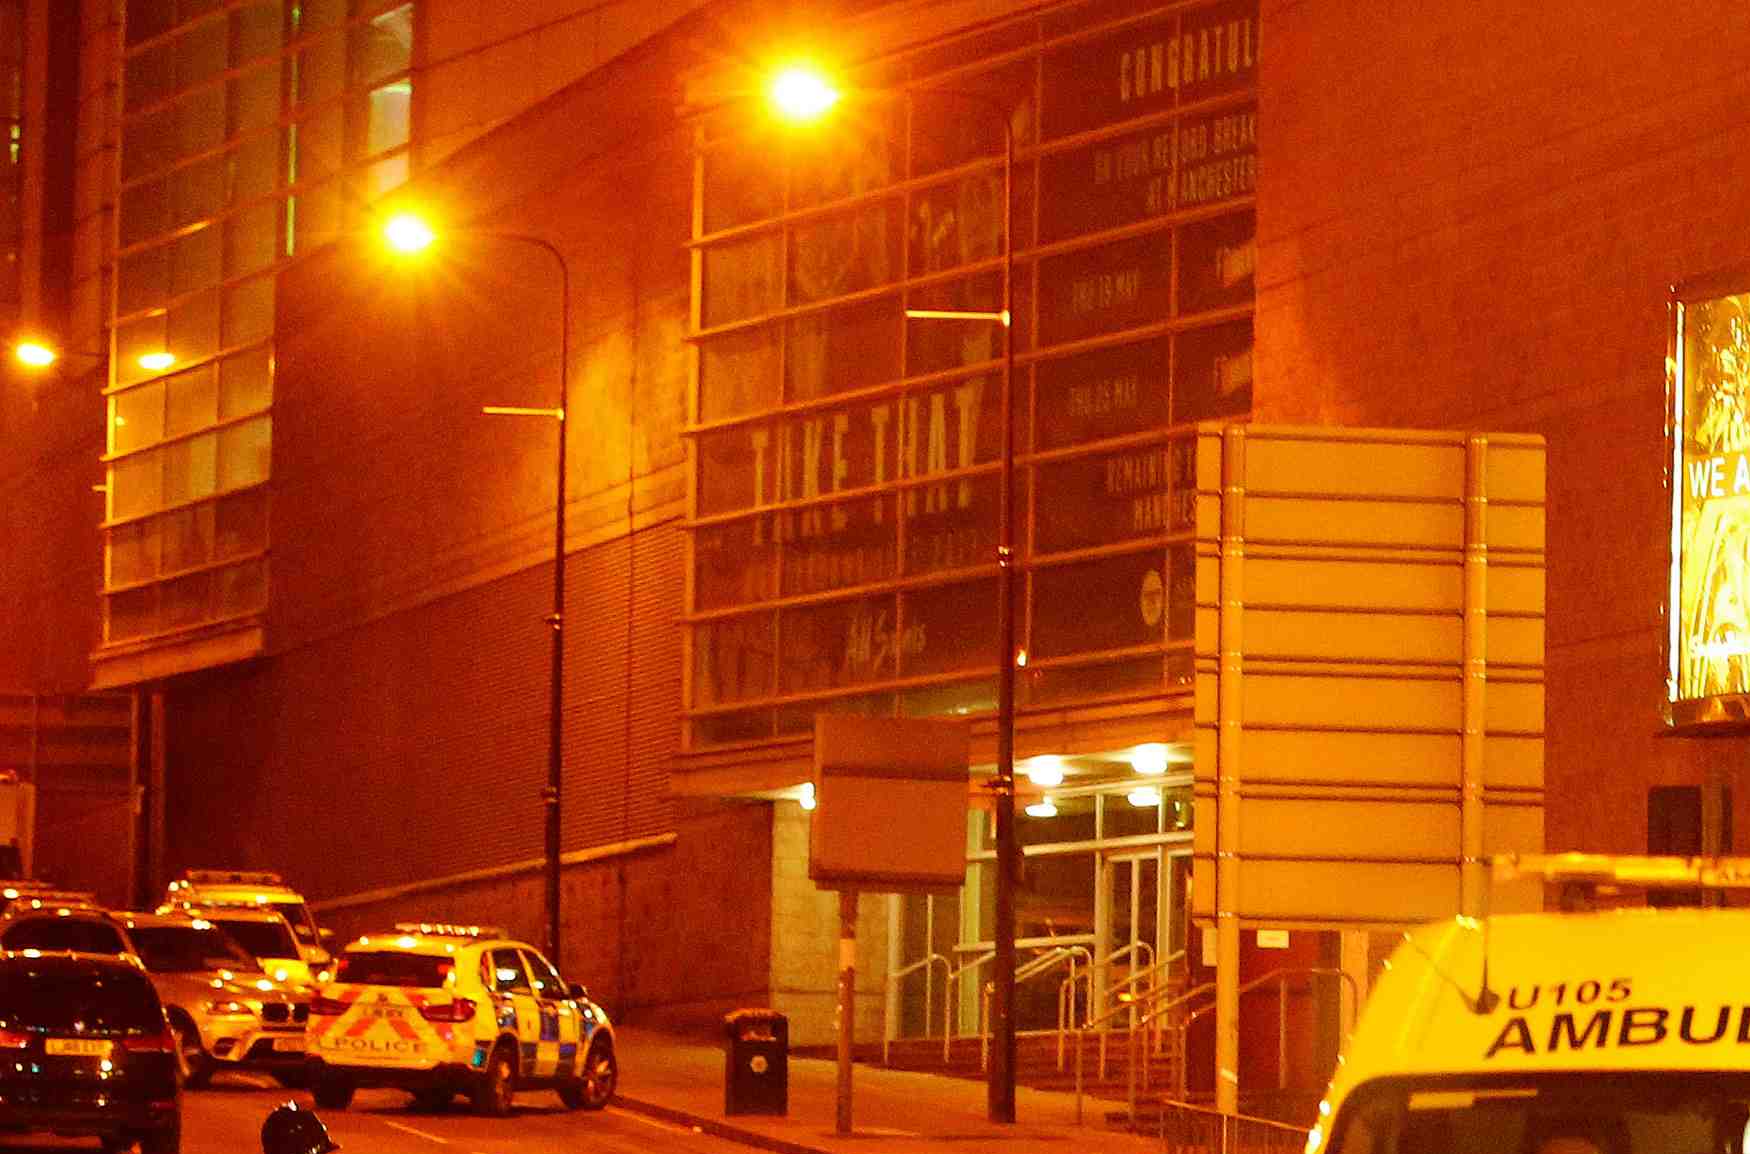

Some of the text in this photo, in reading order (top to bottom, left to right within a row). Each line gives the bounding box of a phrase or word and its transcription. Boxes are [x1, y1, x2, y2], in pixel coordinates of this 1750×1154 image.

[752, 384, 980, 545] TAKE THAT
[1687, 457, 1726, 498] WE
[1507, 977, 1633, 1010] U105
[335, 1039, 424, 1053] POLICE
